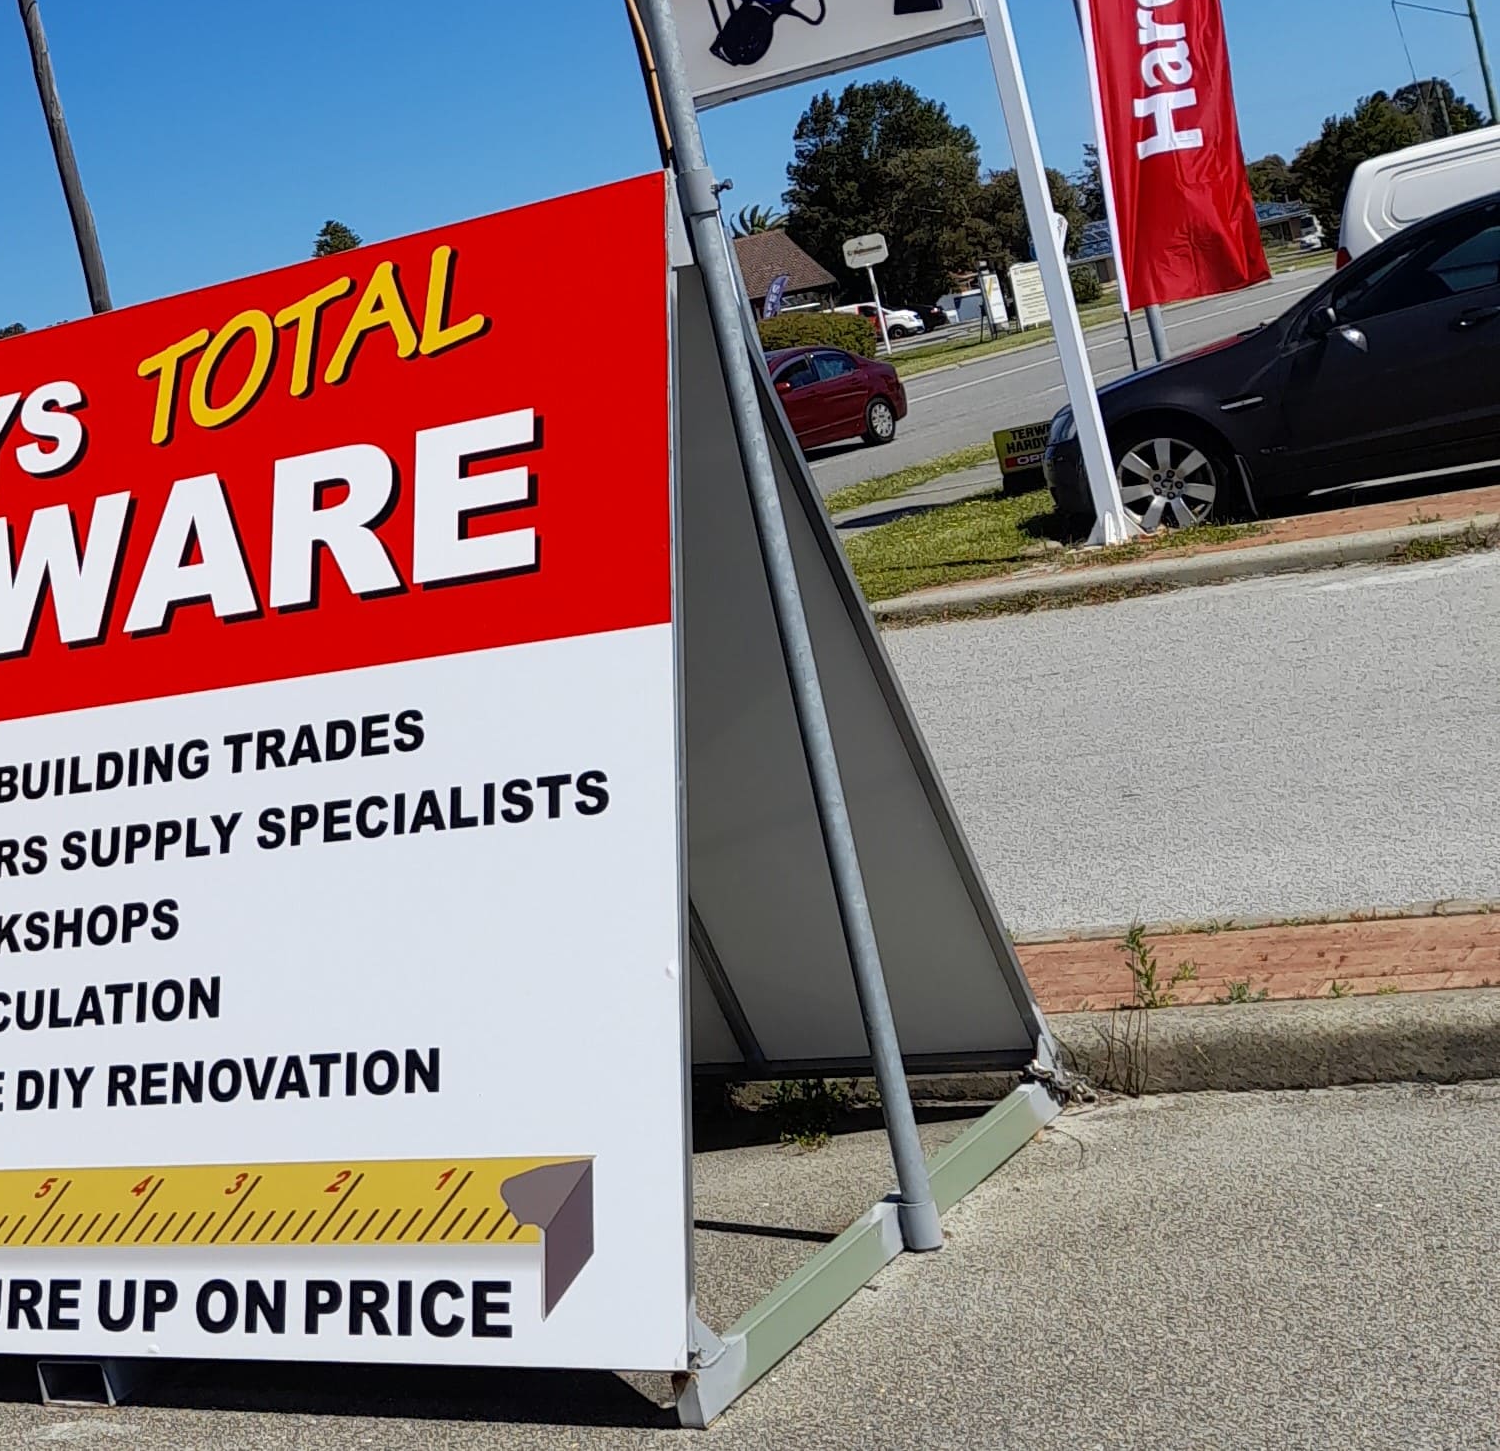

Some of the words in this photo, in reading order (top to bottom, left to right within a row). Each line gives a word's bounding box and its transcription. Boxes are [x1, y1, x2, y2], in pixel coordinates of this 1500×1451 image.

[137, 245, 490, 445] TOTAL
[223, 709, 426, 774] TRADES
[60, 812, 243, 872] SUPPLY
[256, 769, 611, 851] SPECIALISTS
[15, 1065, 96, 1111] DIY
[107, 1047, 441, 1108] RENOVATION
[34, 1177, 58, 1199] 5
[131, 1175, 154, 1197] 4
[224, 1172, 249, 1195] 3
[324, 1170, 352, 1193] 2
[434, 1167, 457, 1191] 1
[98, 1279, 178, 1333] UP
[196, 1278, 287, 1334] ON
[304, 1278, 513, 1338] PRICE
